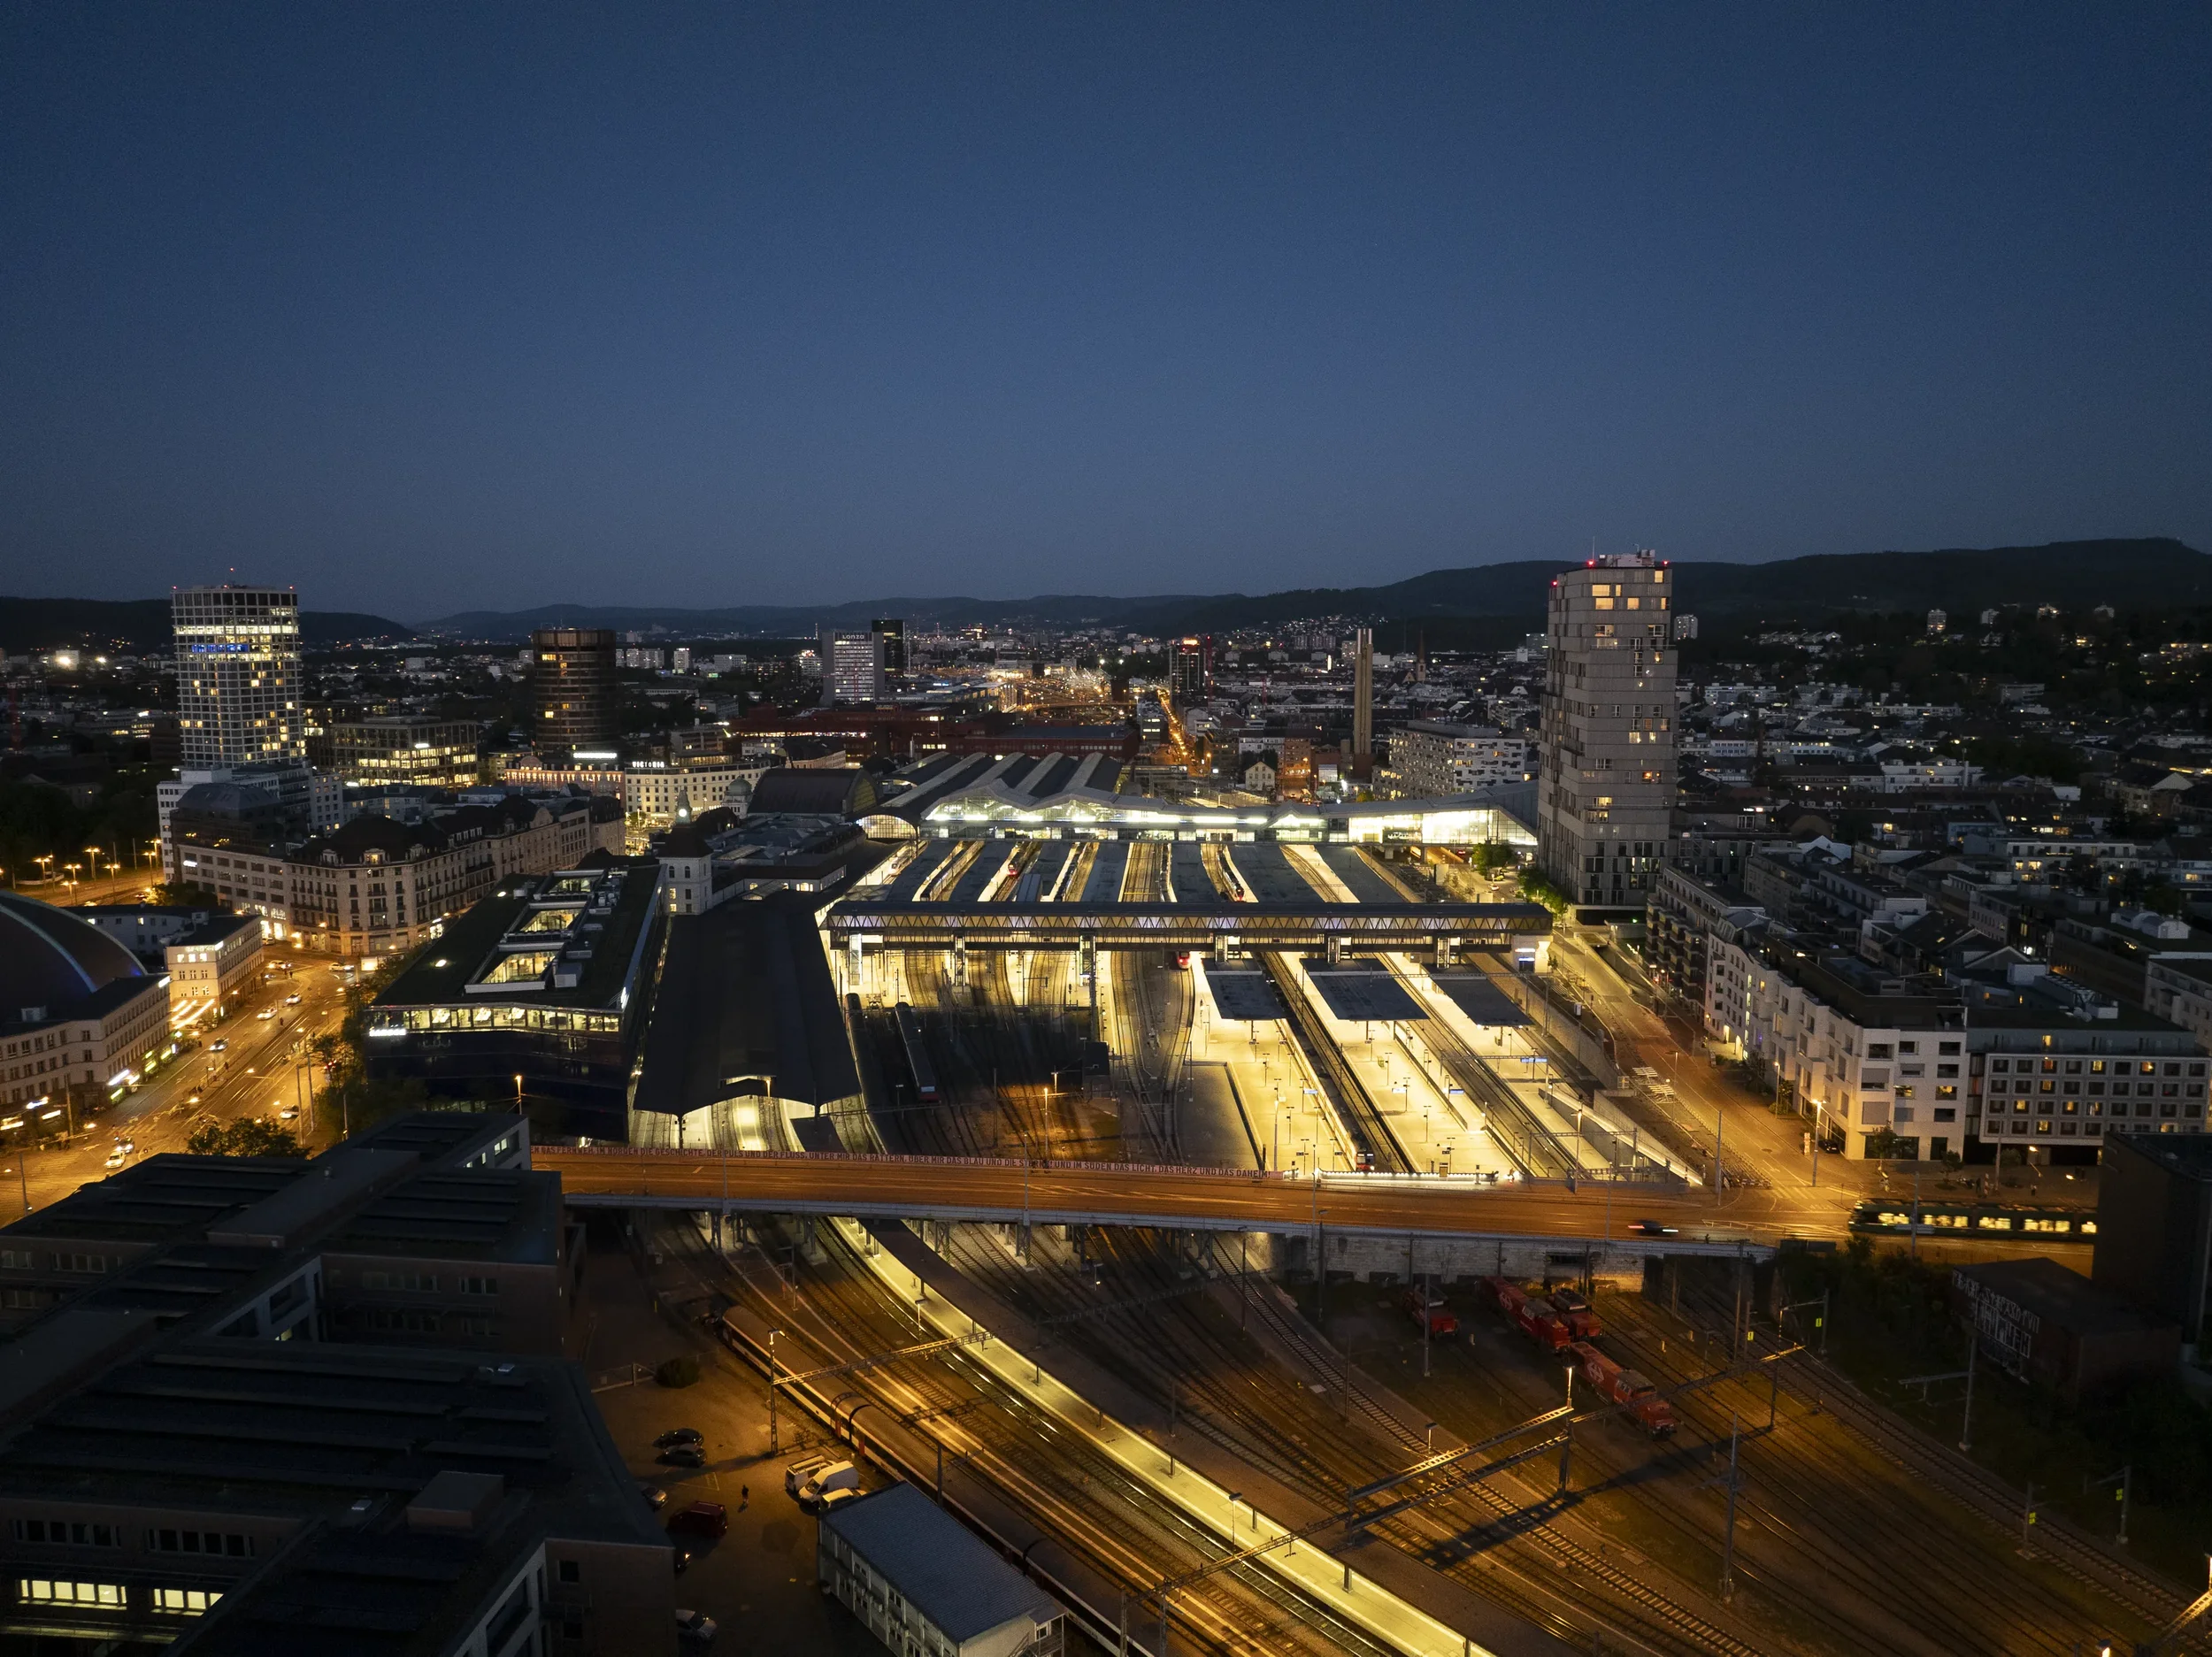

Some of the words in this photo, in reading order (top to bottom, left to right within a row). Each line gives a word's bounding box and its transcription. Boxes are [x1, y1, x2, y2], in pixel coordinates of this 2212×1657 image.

[931, 1155, 945, 1164] MIR
[1176, 1166, 1197, 1175] HERZ
[1200, 1167, 1217, 1176] UND
[1236, 1170, 1271, 1178] DAHEIM!
